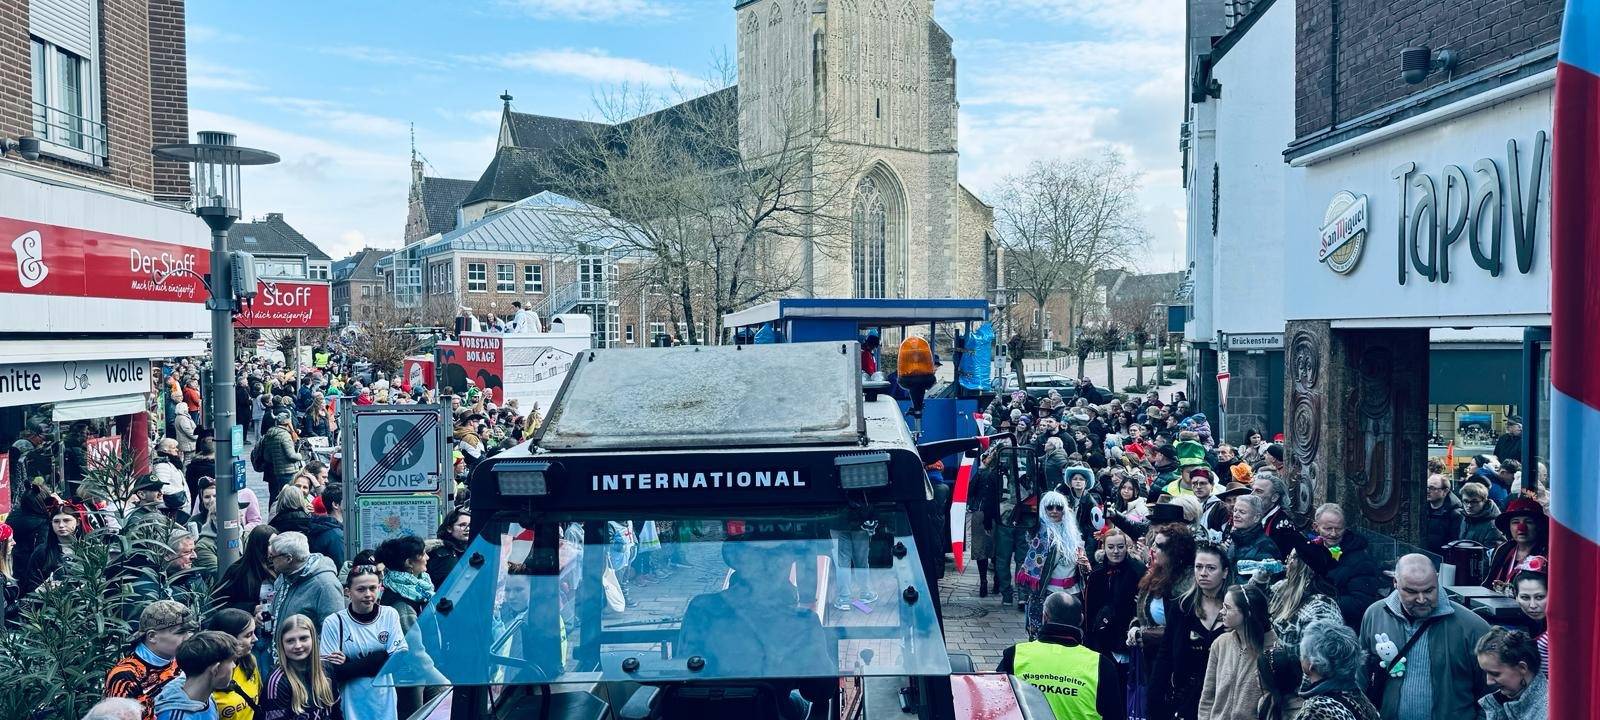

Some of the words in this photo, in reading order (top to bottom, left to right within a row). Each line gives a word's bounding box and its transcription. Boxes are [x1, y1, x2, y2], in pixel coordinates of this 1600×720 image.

[1335, 203, 1365, 240] Miguel
[130, 248, 158, 273] Der
[161, 252, 195, 278] Stoff
[263, 287, 311, 306] Stoff
[254, 310, 271, 319] dich
[273, 309, 313, 323] einzigartig!
[460, 337, 500, 350] VORSTAND
[1232, 336, 1279, 345] Brückenstraße
[466, 350, 496, 363] BOKAGE
[105, 360, 143, 383] Wolle
[0, 368, 42, 393] nitte
[378, 473, 419, 487] ZONE
[592, 470, 806, 491] INTERNATIONAL
[1022, 673, 1086, 687] Wagenbegleiter
